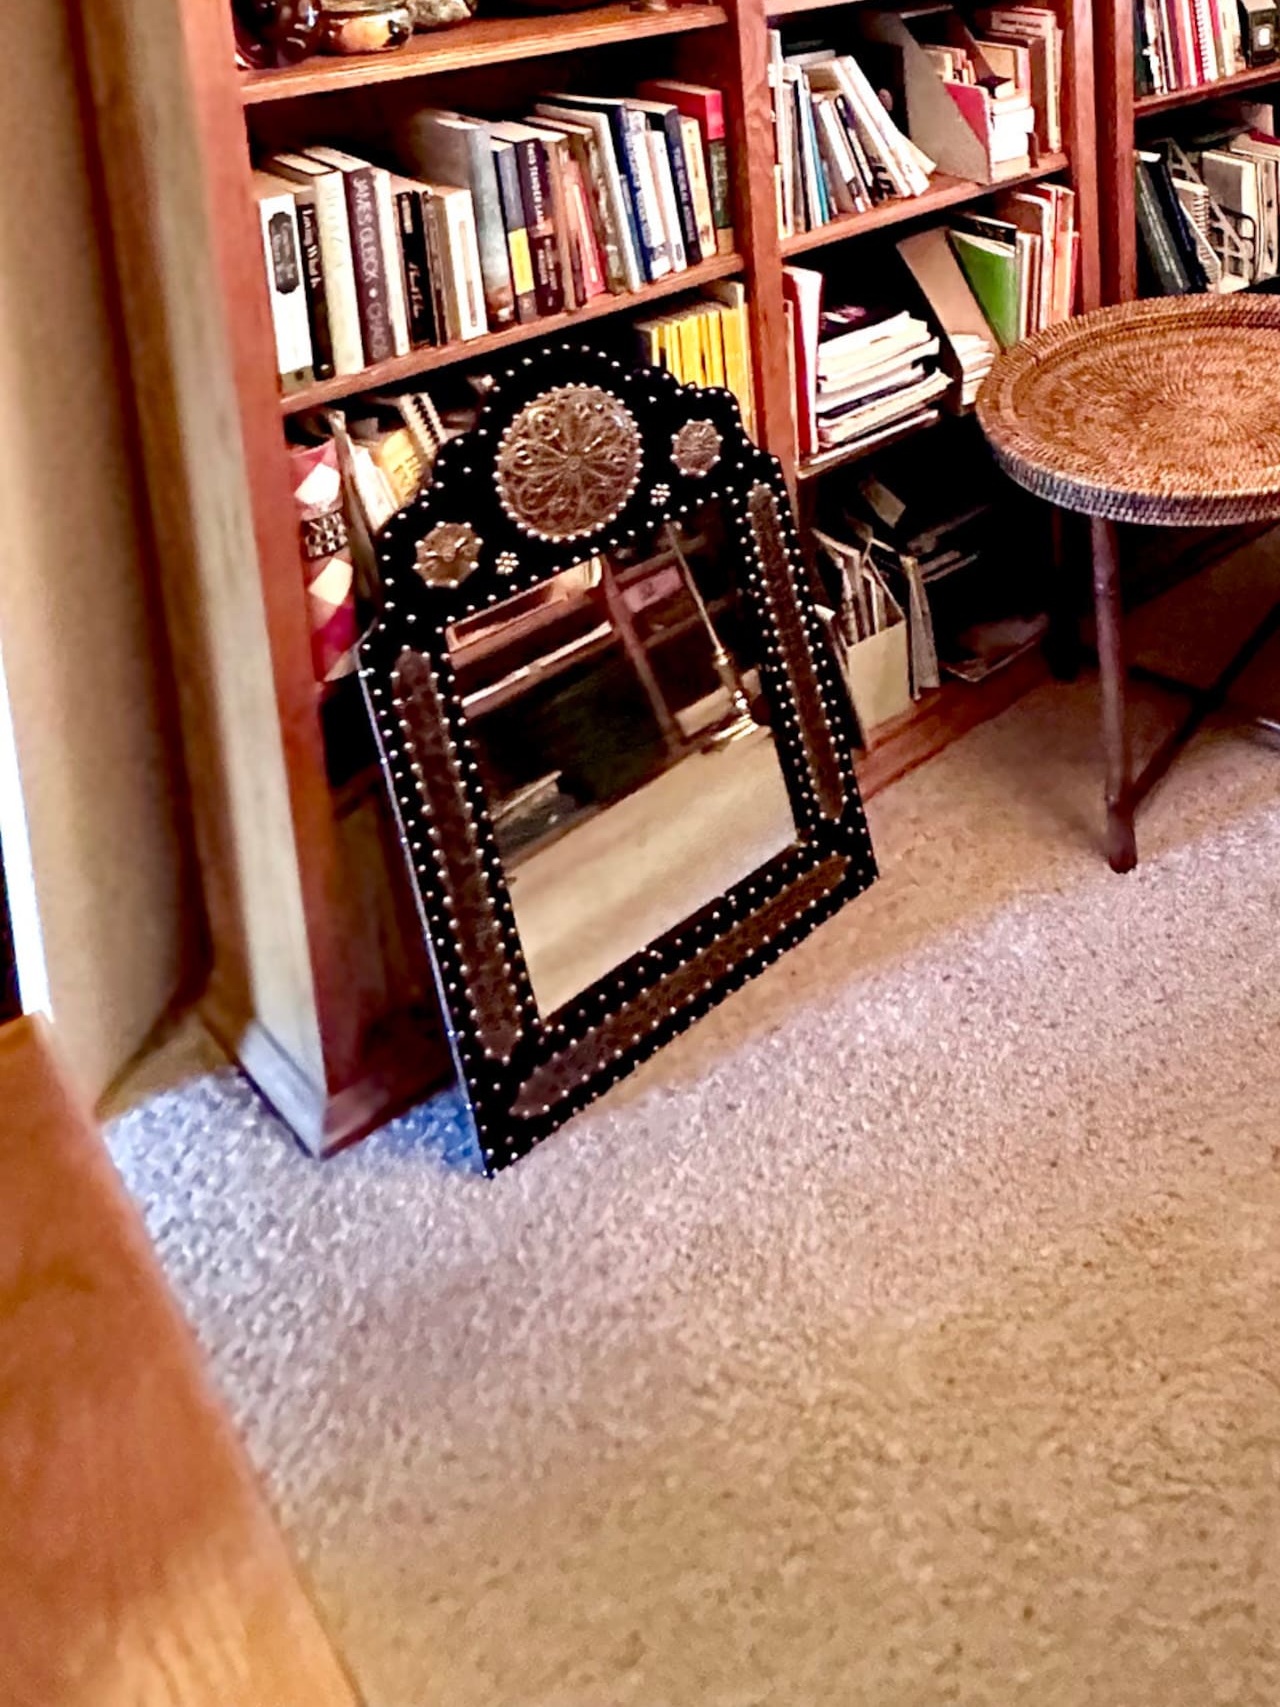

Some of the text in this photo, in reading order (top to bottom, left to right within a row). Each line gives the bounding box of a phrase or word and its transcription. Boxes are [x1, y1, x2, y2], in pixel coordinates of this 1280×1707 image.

[525, 142, 545, 230] THIS TENDER LAND
[350, 176, 389, 358] JAMES GLEICK CHAOS
